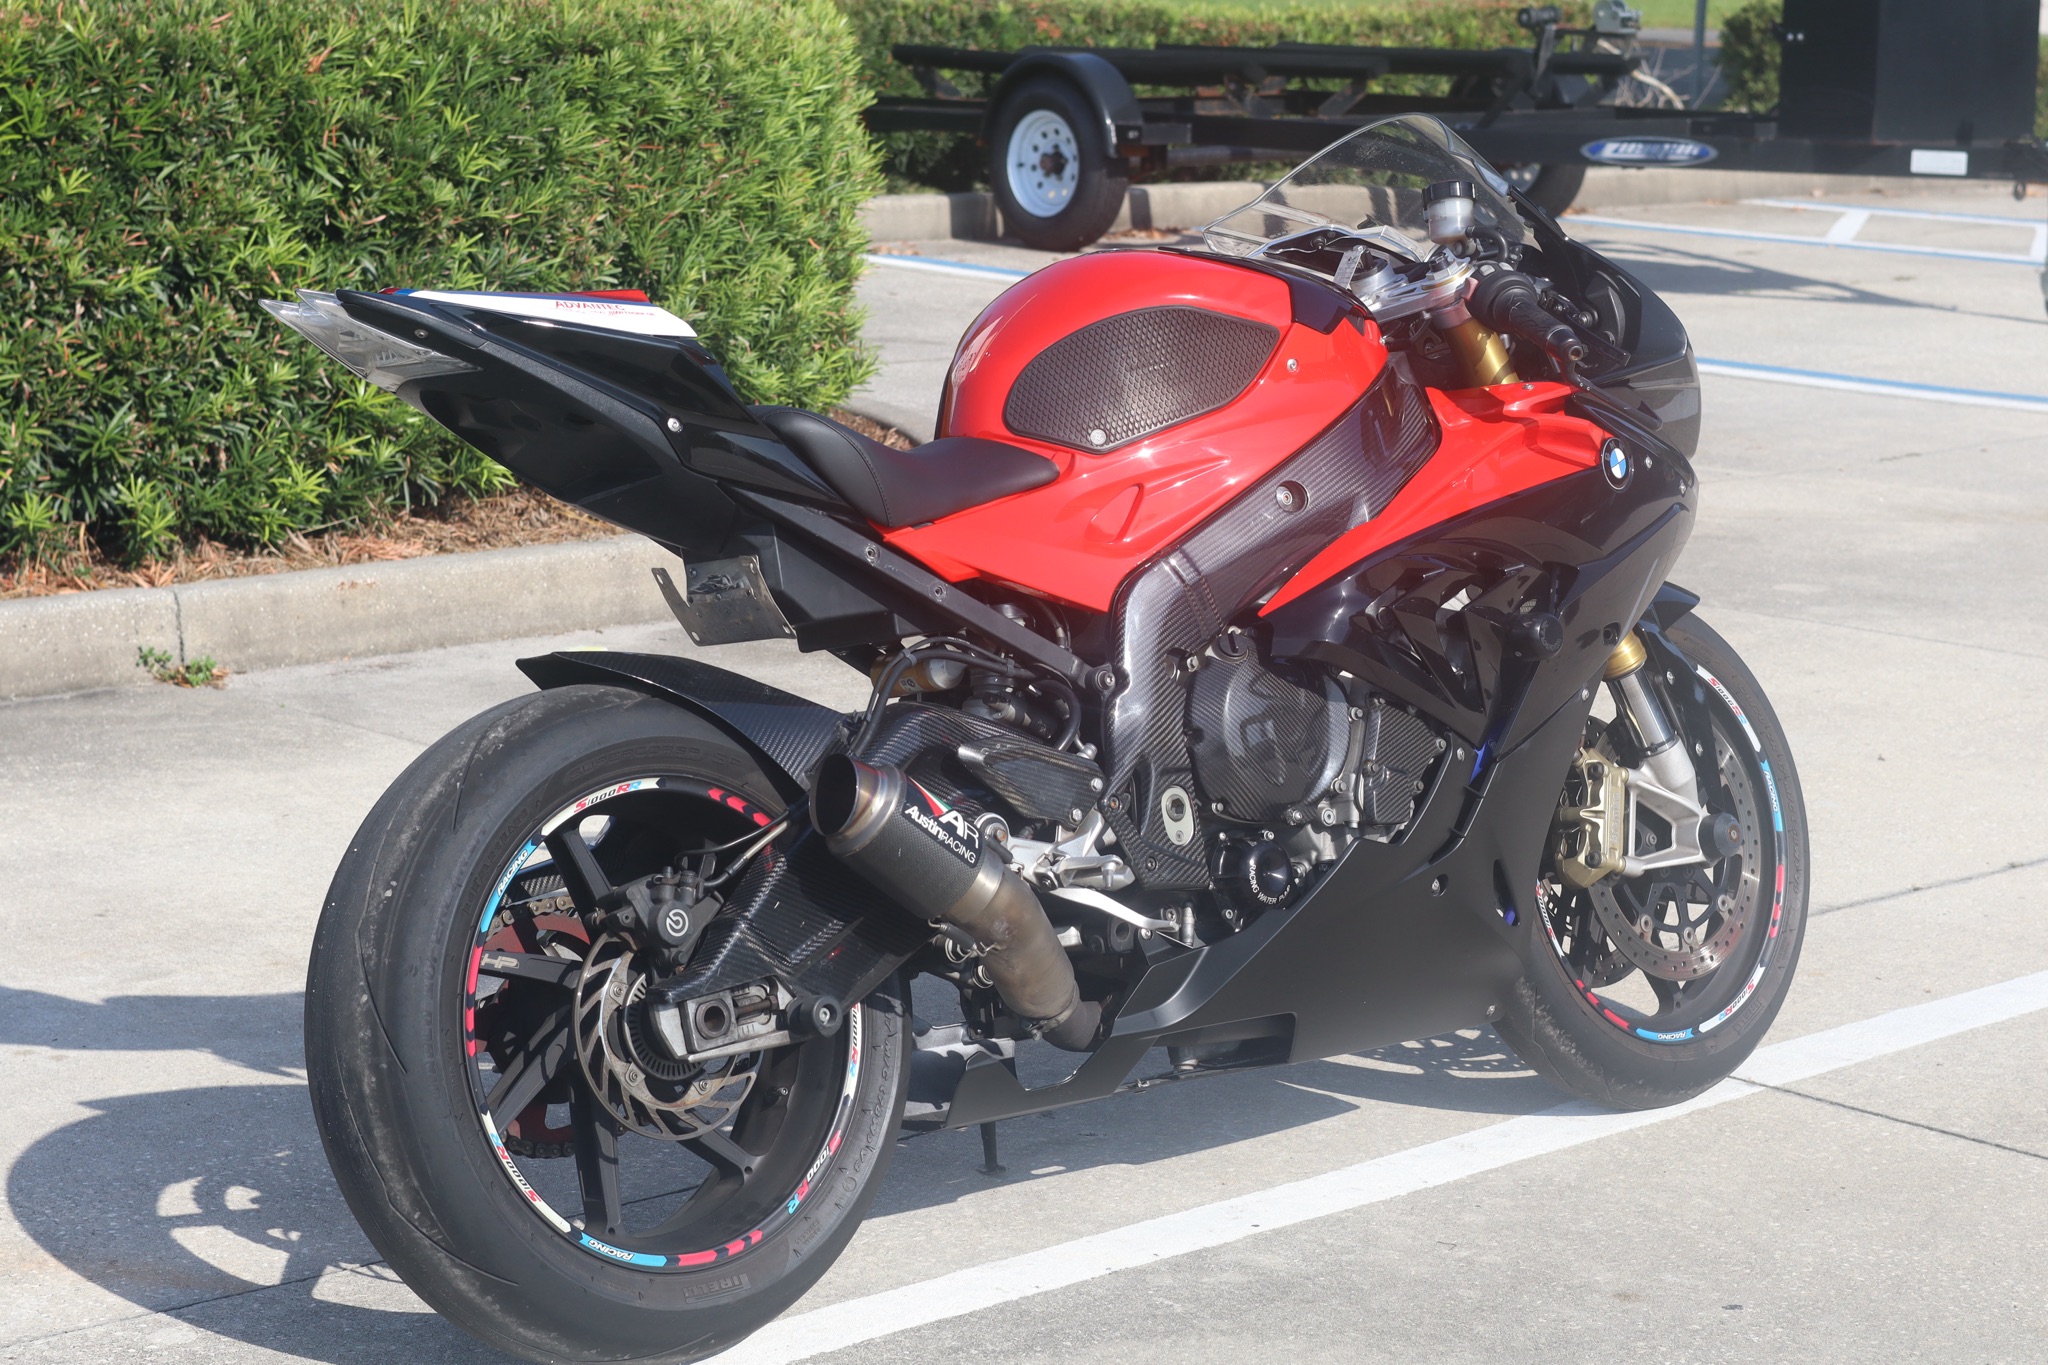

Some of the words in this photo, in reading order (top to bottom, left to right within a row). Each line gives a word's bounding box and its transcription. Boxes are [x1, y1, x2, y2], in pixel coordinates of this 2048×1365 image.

[555, 300, 626, 311] ADVANTEC
[574, 780, 643, 813] S1000RR
[1764, 771, 1779, 812] RACING
[496, 850, 529, 896] RACING
[1249, 865, 1260, 893] RACING
[1257, 892, 1278, 905] WATER
[1719, 979, 1754, 1021] S1000RR
[1657, 1031, 1686, 1040] RACING
[489, 1133, 542, 1202] S1000RR
[786, 1130, 843, 1214] S1000RR
[589, 1240, 634, 1261] RACING
[682, 1272, 752, 1307] PIRELLI
